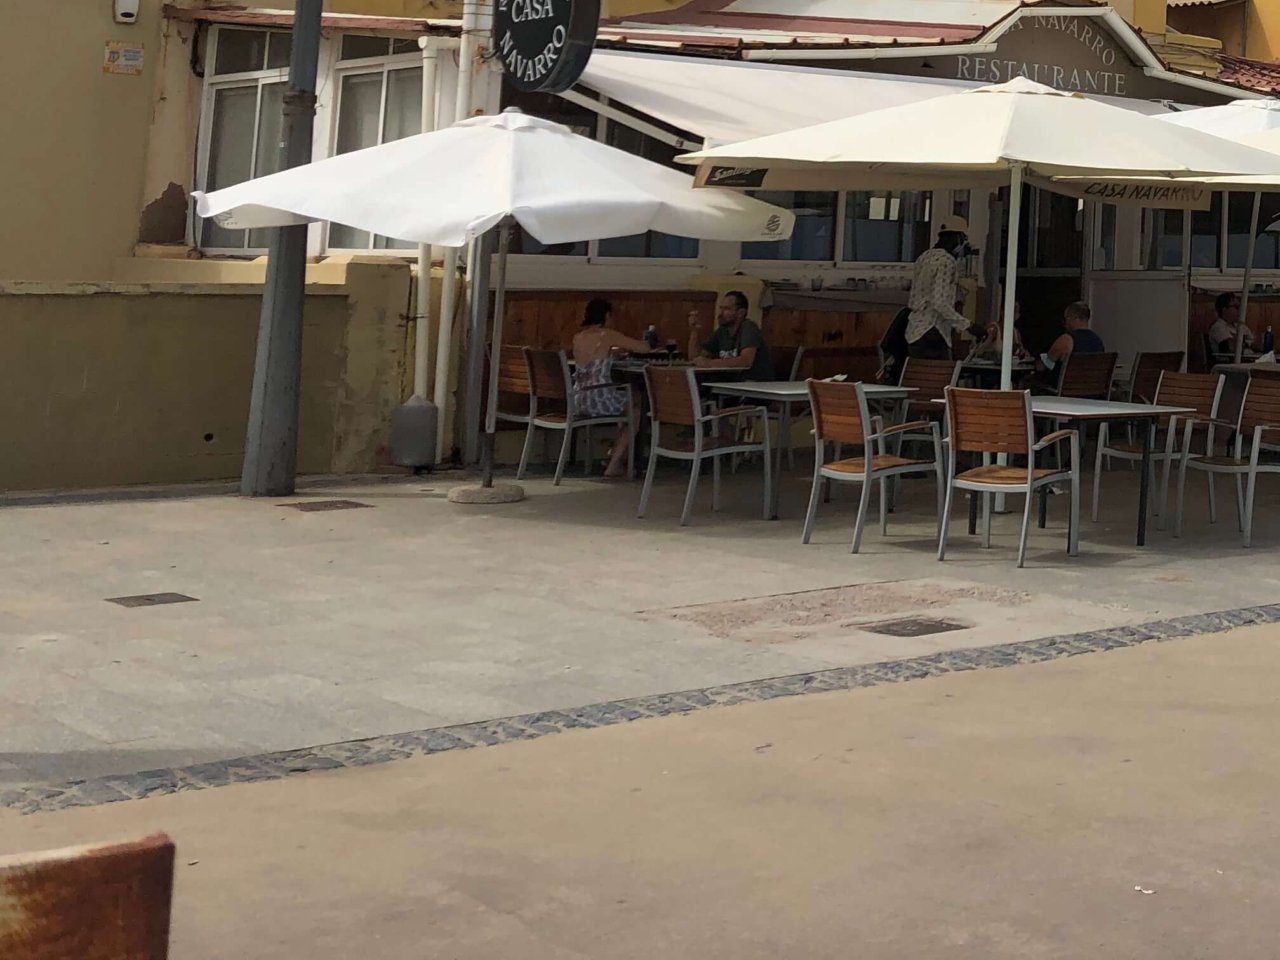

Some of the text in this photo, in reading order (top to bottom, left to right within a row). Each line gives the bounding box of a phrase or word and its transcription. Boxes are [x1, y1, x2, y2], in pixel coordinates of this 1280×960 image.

[500, 24, 566, 82] NAVARRO
[1034, 14, 1116, 66] NAVARRO
[957, 55, 1127, 96] RESTAURANTE
[1084, 182, 1128, 199] CASA
